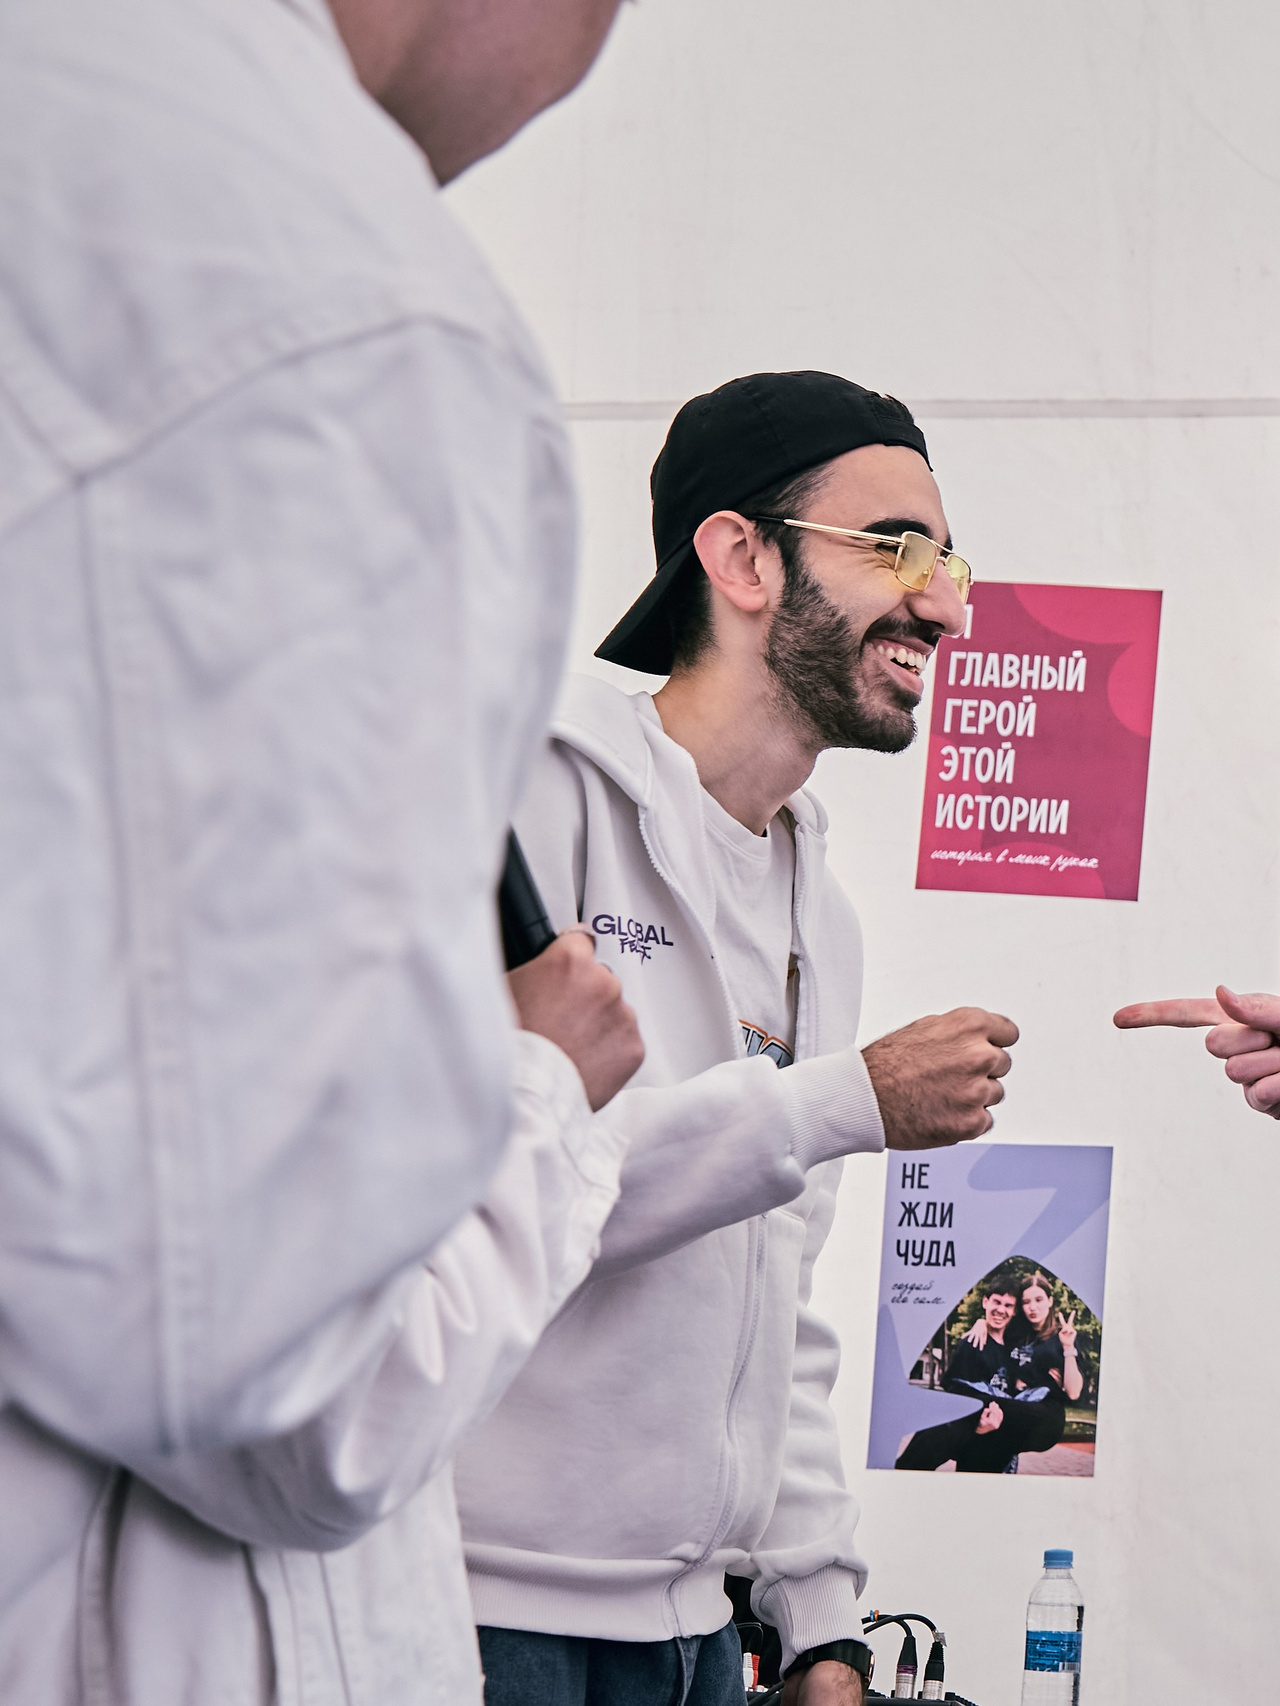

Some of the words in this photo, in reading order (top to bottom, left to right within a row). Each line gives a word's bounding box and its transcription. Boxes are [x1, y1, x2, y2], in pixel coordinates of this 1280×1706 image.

[948, 650, 1087, 692] ГЛАВНЫЙ
[943, 695, 1037, 737] ГЕРОЙ
[938, 742, 1015, 784] ЭТОЙ
[935, 793, 1069, 834] ИСТОРИИ
[930, 849, 993, 866] история
[996, 848, 1009, 863] в
[1009, 853, 1050, 866] моих
[1050, 854, 1099, 872] руках
[592, 914, 674, 946] GLOBAL
[901, 1162, 930, 1189] НЕ
[898, 1201, 954, 1228] ЖДИ
[896, 1239, 956, 1267] ЧУДА
